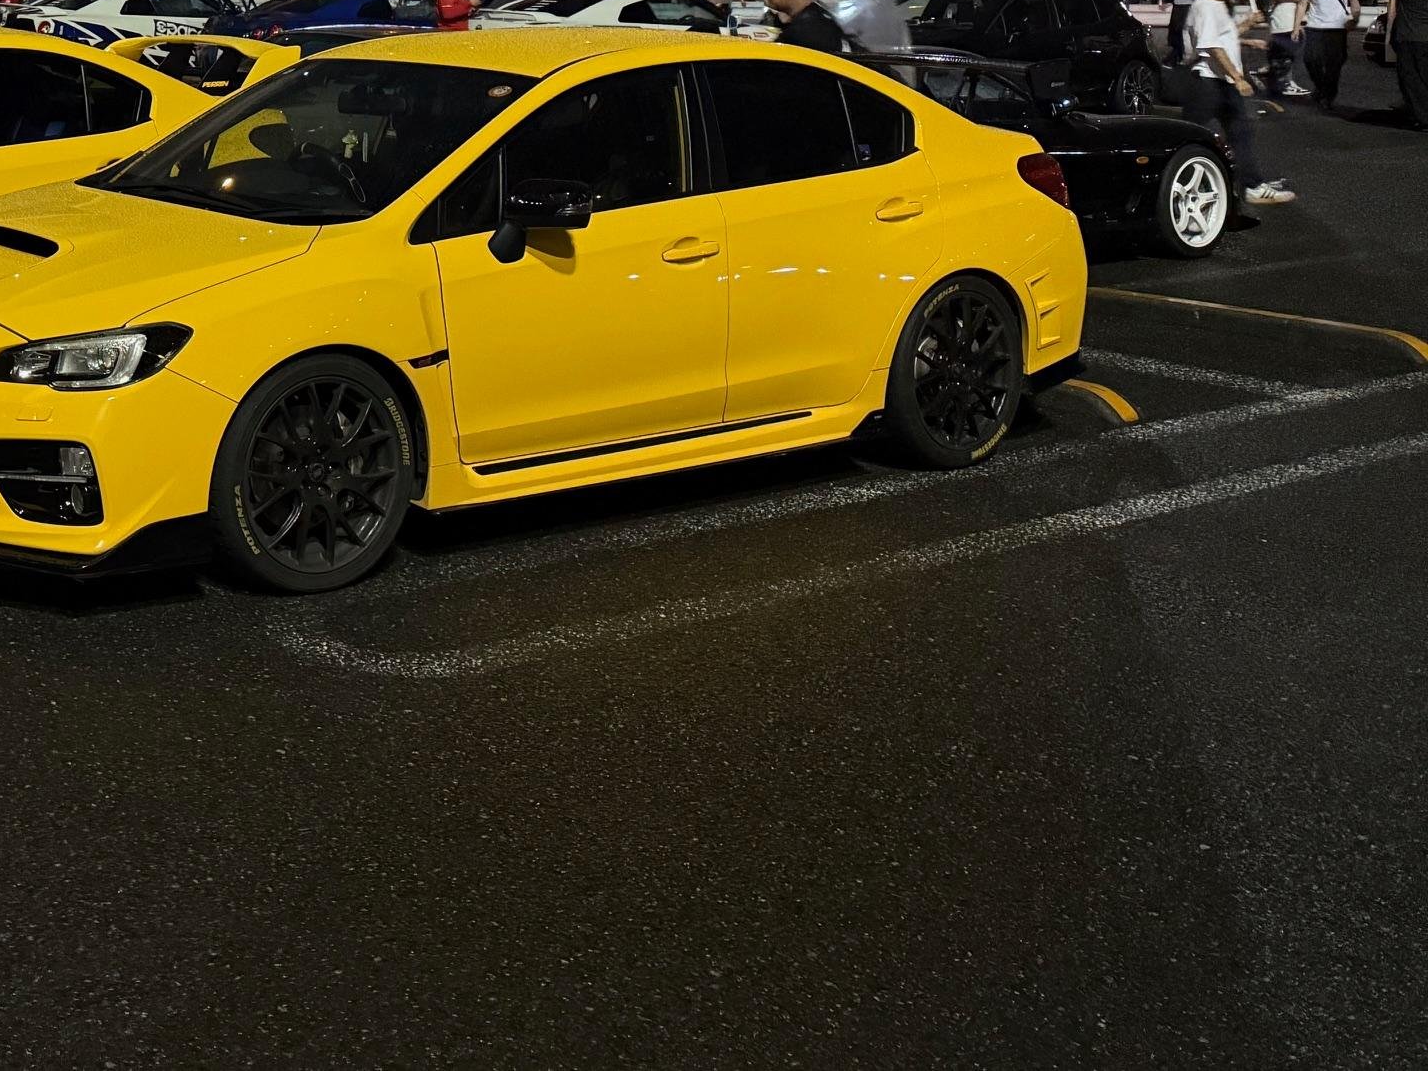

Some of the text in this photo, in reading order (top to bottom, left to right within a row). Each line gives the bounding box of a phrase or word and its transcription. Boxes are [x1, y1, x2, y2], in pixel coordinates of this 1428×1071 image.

[156, 21, 203, 36] spar
[202, 80, 229, 88] PERRIN
[384, 397, 411, 466] BRIDGESTONE
[234, 485, 260, 555] POTENZA
